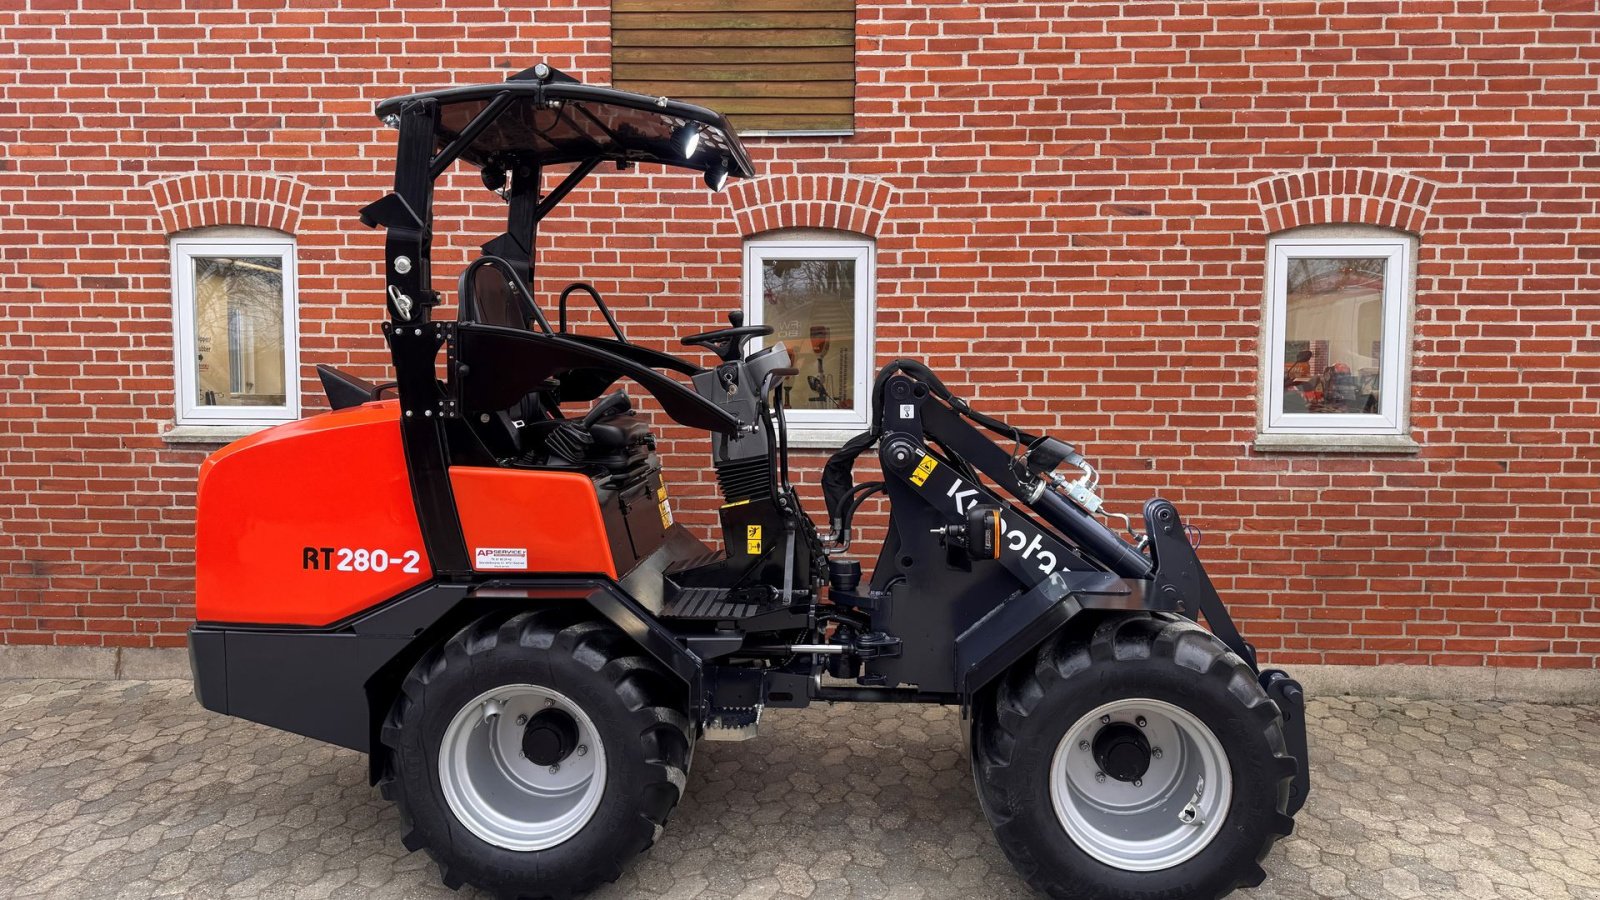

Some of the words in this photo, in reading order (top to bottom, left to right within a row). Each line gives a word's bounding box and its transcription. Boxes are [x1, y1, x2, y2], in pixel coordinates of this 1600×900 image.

[946, 478, 1071, 576] Kota
[302, 547, 421, 574] RT280-2
[477, 549, 494, 557] AP
